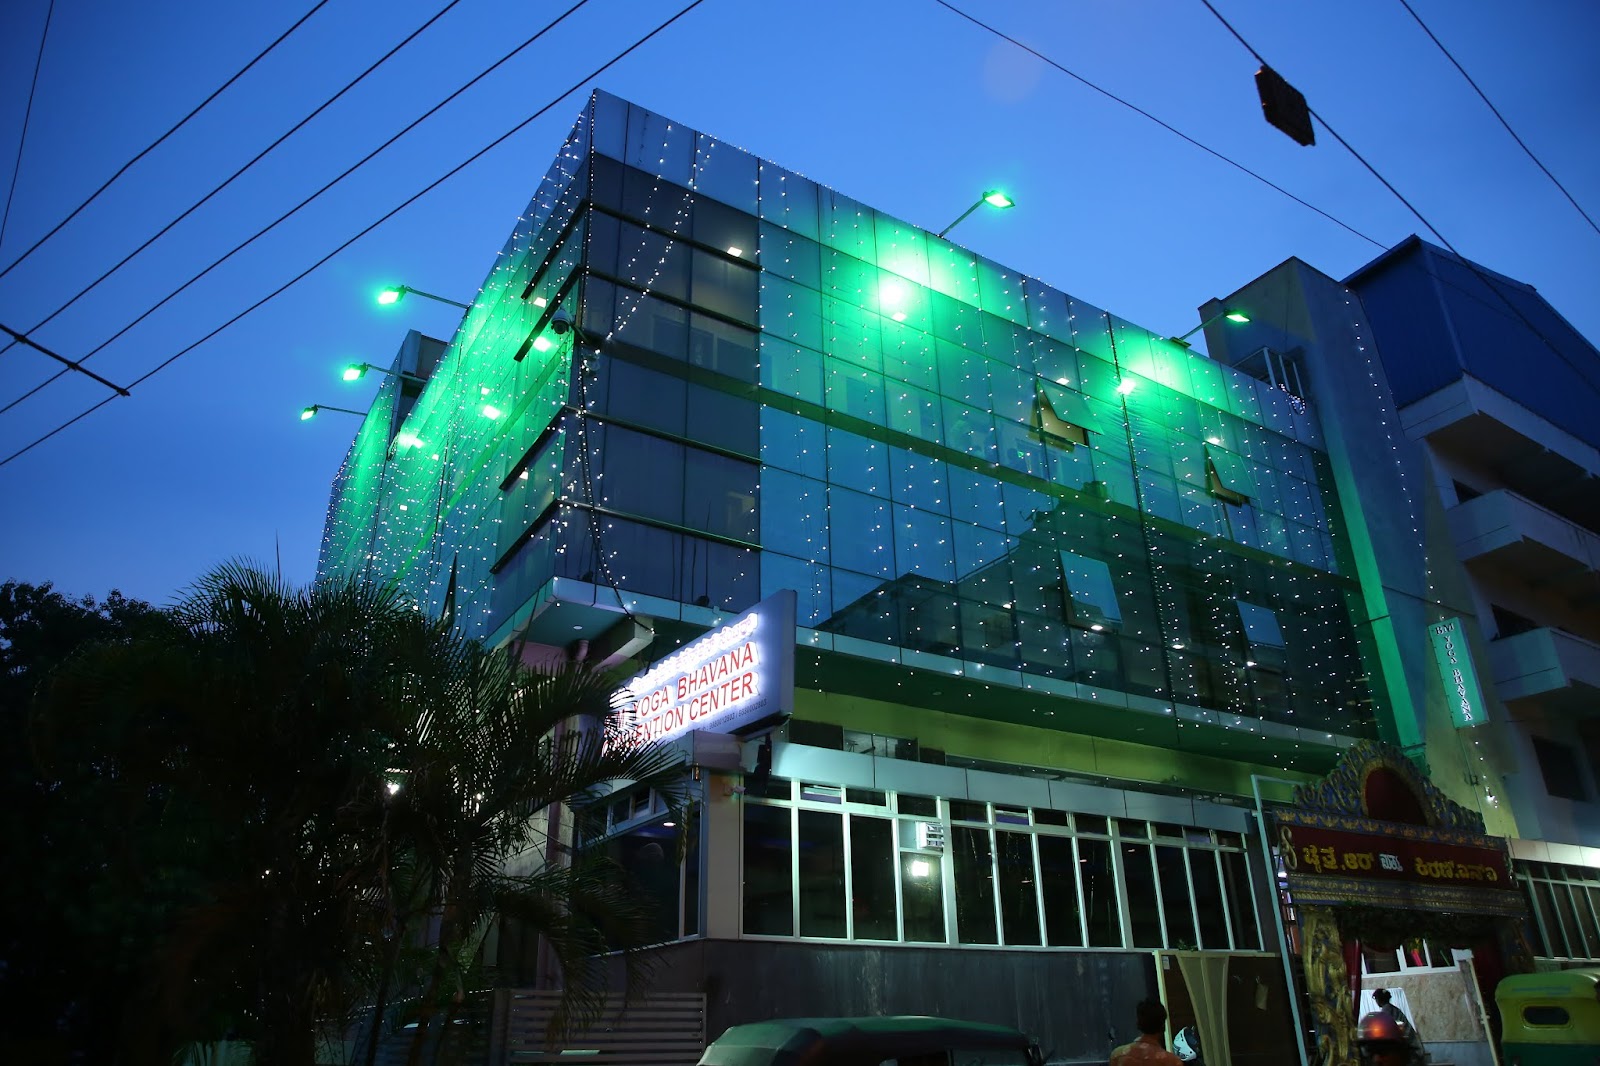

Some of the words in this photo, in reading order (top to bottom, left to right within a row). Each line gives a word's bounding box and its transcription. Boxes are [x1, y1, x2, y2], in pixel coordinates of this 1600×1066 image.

[1435, 623, 1454, 635] BM
[1444, 635, 1457, 664] YOGA
[633, 687, 669, 717] YOGA
[677, 642, 753, 700] BHAVANA
[689, 672, 753, 721] CENTER
[1452, 669, 1473, 721] BHAVANA
